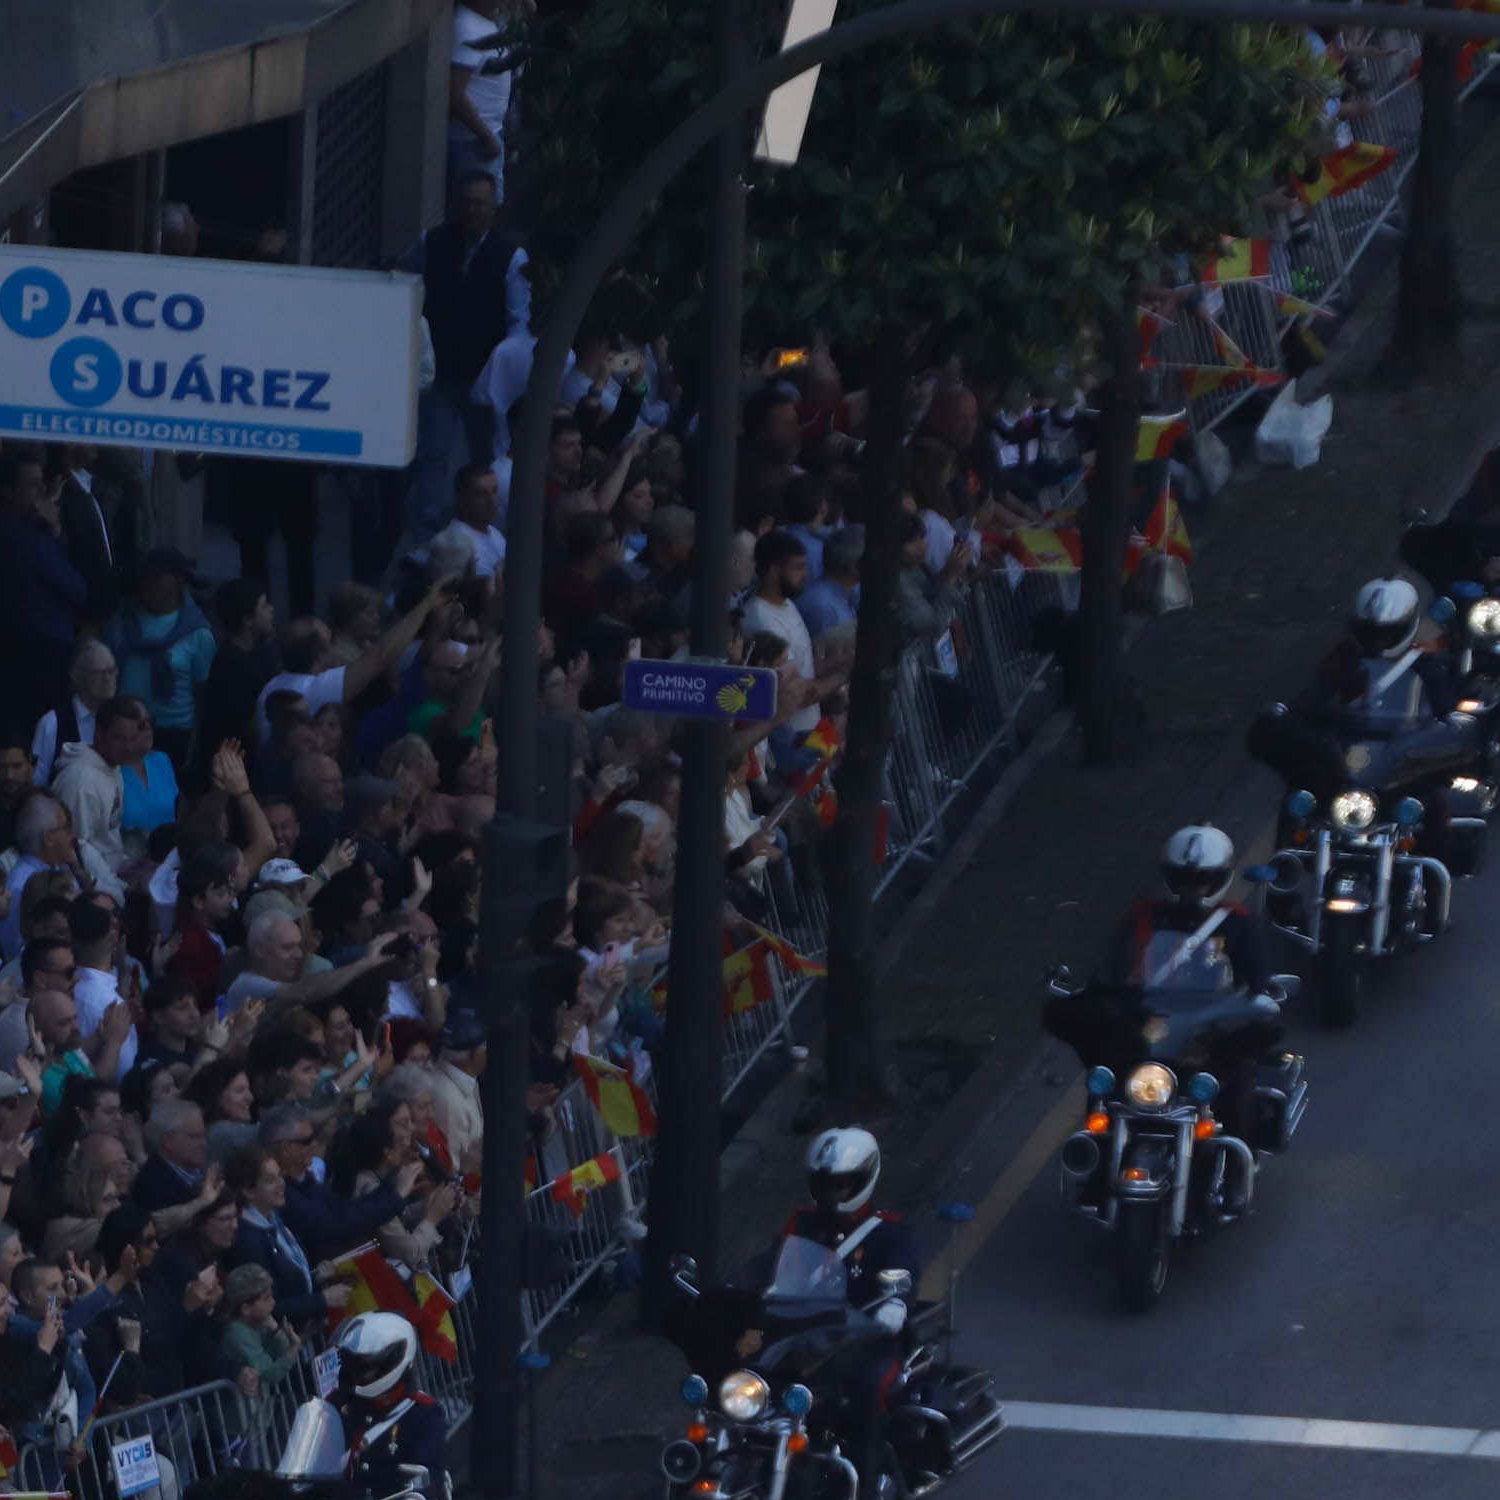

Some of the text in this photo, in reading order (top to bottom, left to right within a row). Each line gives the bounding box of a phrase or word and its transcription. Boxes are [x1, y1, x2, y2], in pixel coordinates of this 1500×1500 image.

[19, 283, 205, 332] PACO
[70, 352, 332, 412] SUÁREZ
[20, 412, 302, 450] ELECTRODOMÉSTICOS
[641, 672, 707, 691] CAMINO
[641, 687, 706, 704] PRIMITIVO
